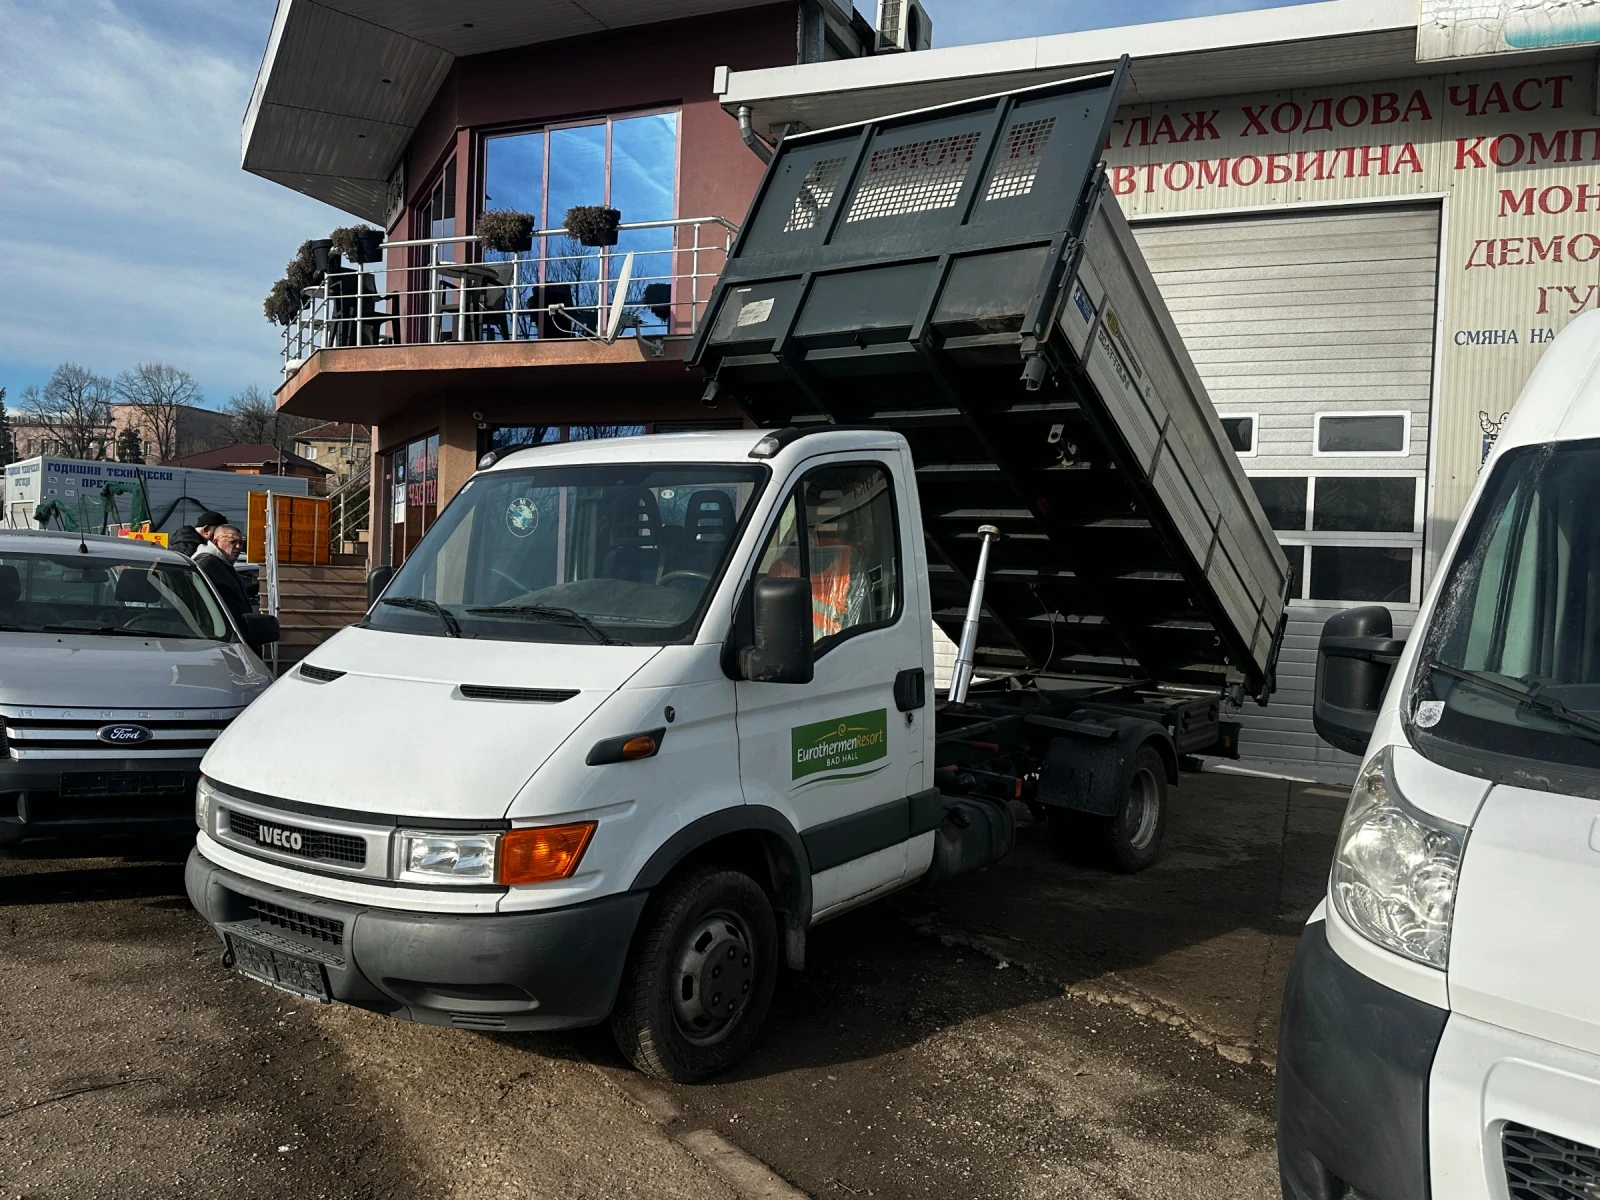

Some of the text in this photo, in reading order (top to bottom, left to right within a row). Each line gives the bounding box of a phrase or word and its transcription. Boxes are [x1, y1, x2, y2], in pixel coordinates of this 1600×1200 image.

[1240, 88, 1432, 137] ХОДОВА
[1448, 75, 1573, 116] ЧАСТ
[1112, 128, 1600, 196] ВТОМОБИЛНА КОМП
[1498, 183, 1600, 217] МОН
[1464, 233, 1600, 271] ДЕМО
[1536, 285, 1600, 315] ГУ
[1454, 328, 1555, 346] СМЯНА НА
[47, 462, 102, 476] ГОДИШНИ
[110, 727, 140, 741] Ford
[826, 752, 858, 767] BAD HALL
[258, 825, 303, 850] IVECO
